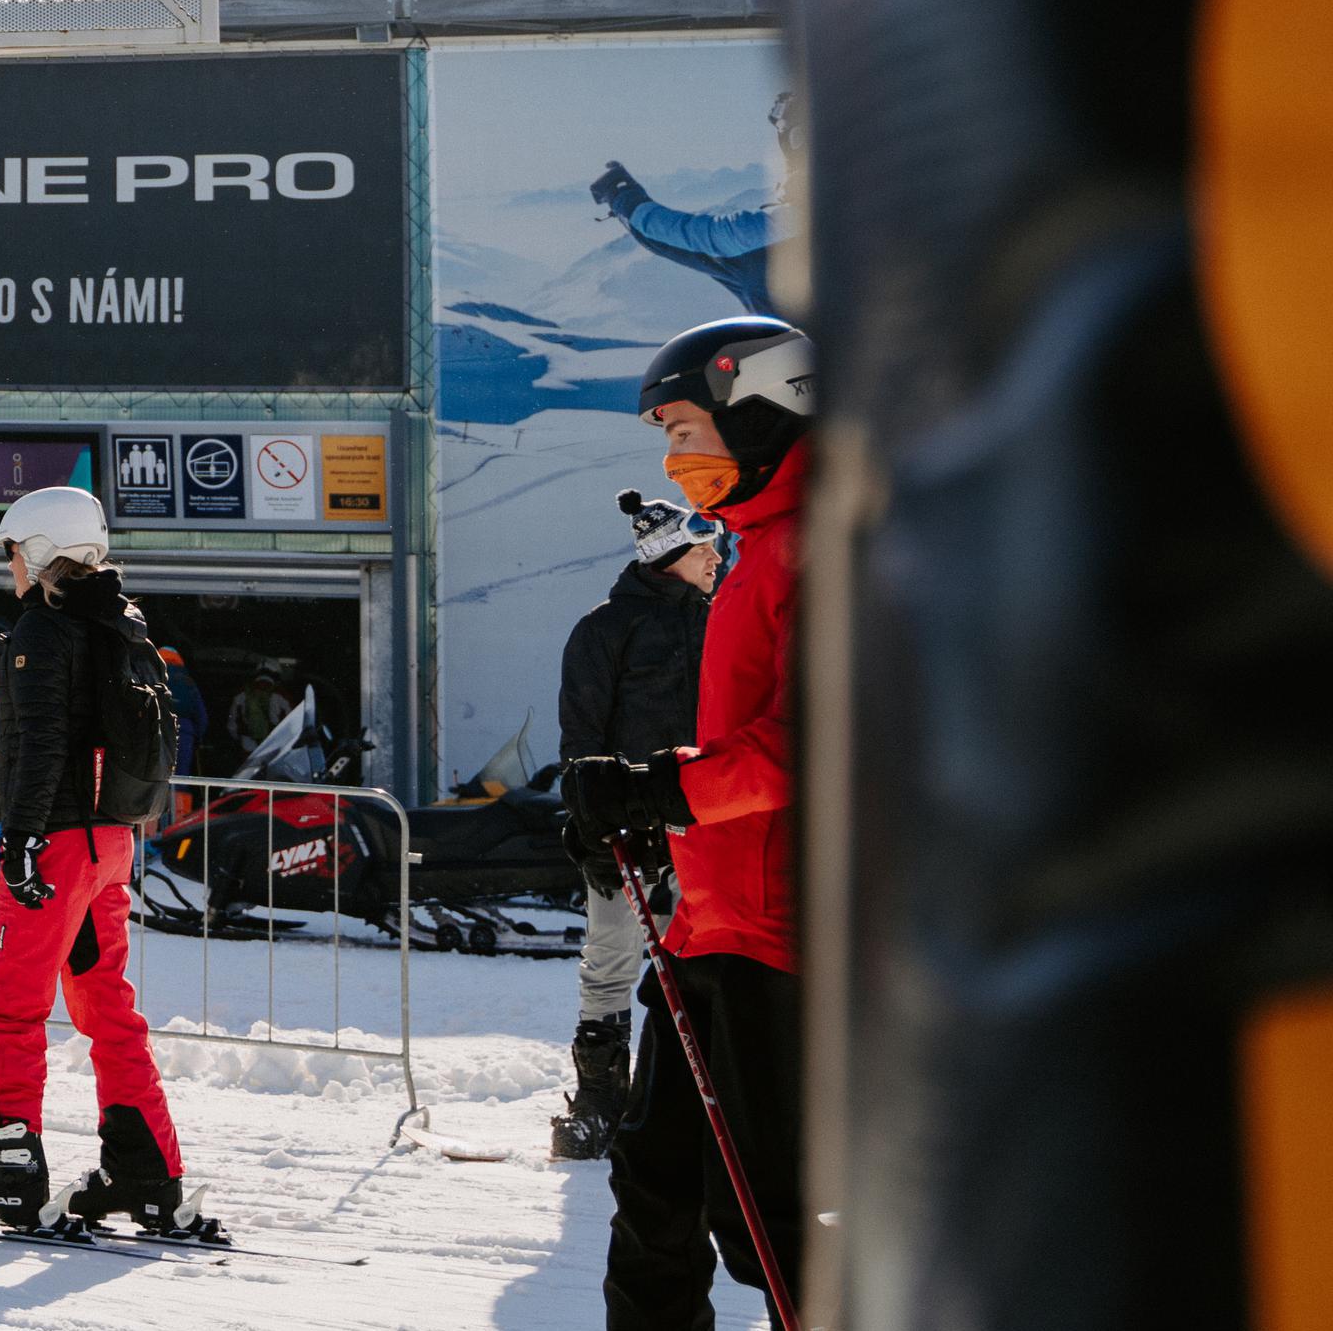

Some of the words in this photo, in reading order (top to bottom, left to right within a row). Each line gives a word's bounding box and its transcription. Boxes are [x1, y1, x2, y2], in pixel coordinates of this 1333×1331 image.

[116, 152, 355, 202] PRO
[32, 277, 54, 324] S
[69, 267, 184, 324] NÁMI!
[267, 838, 327, 871] LYNX
[680, 1031, 705, 1089] Alpine
